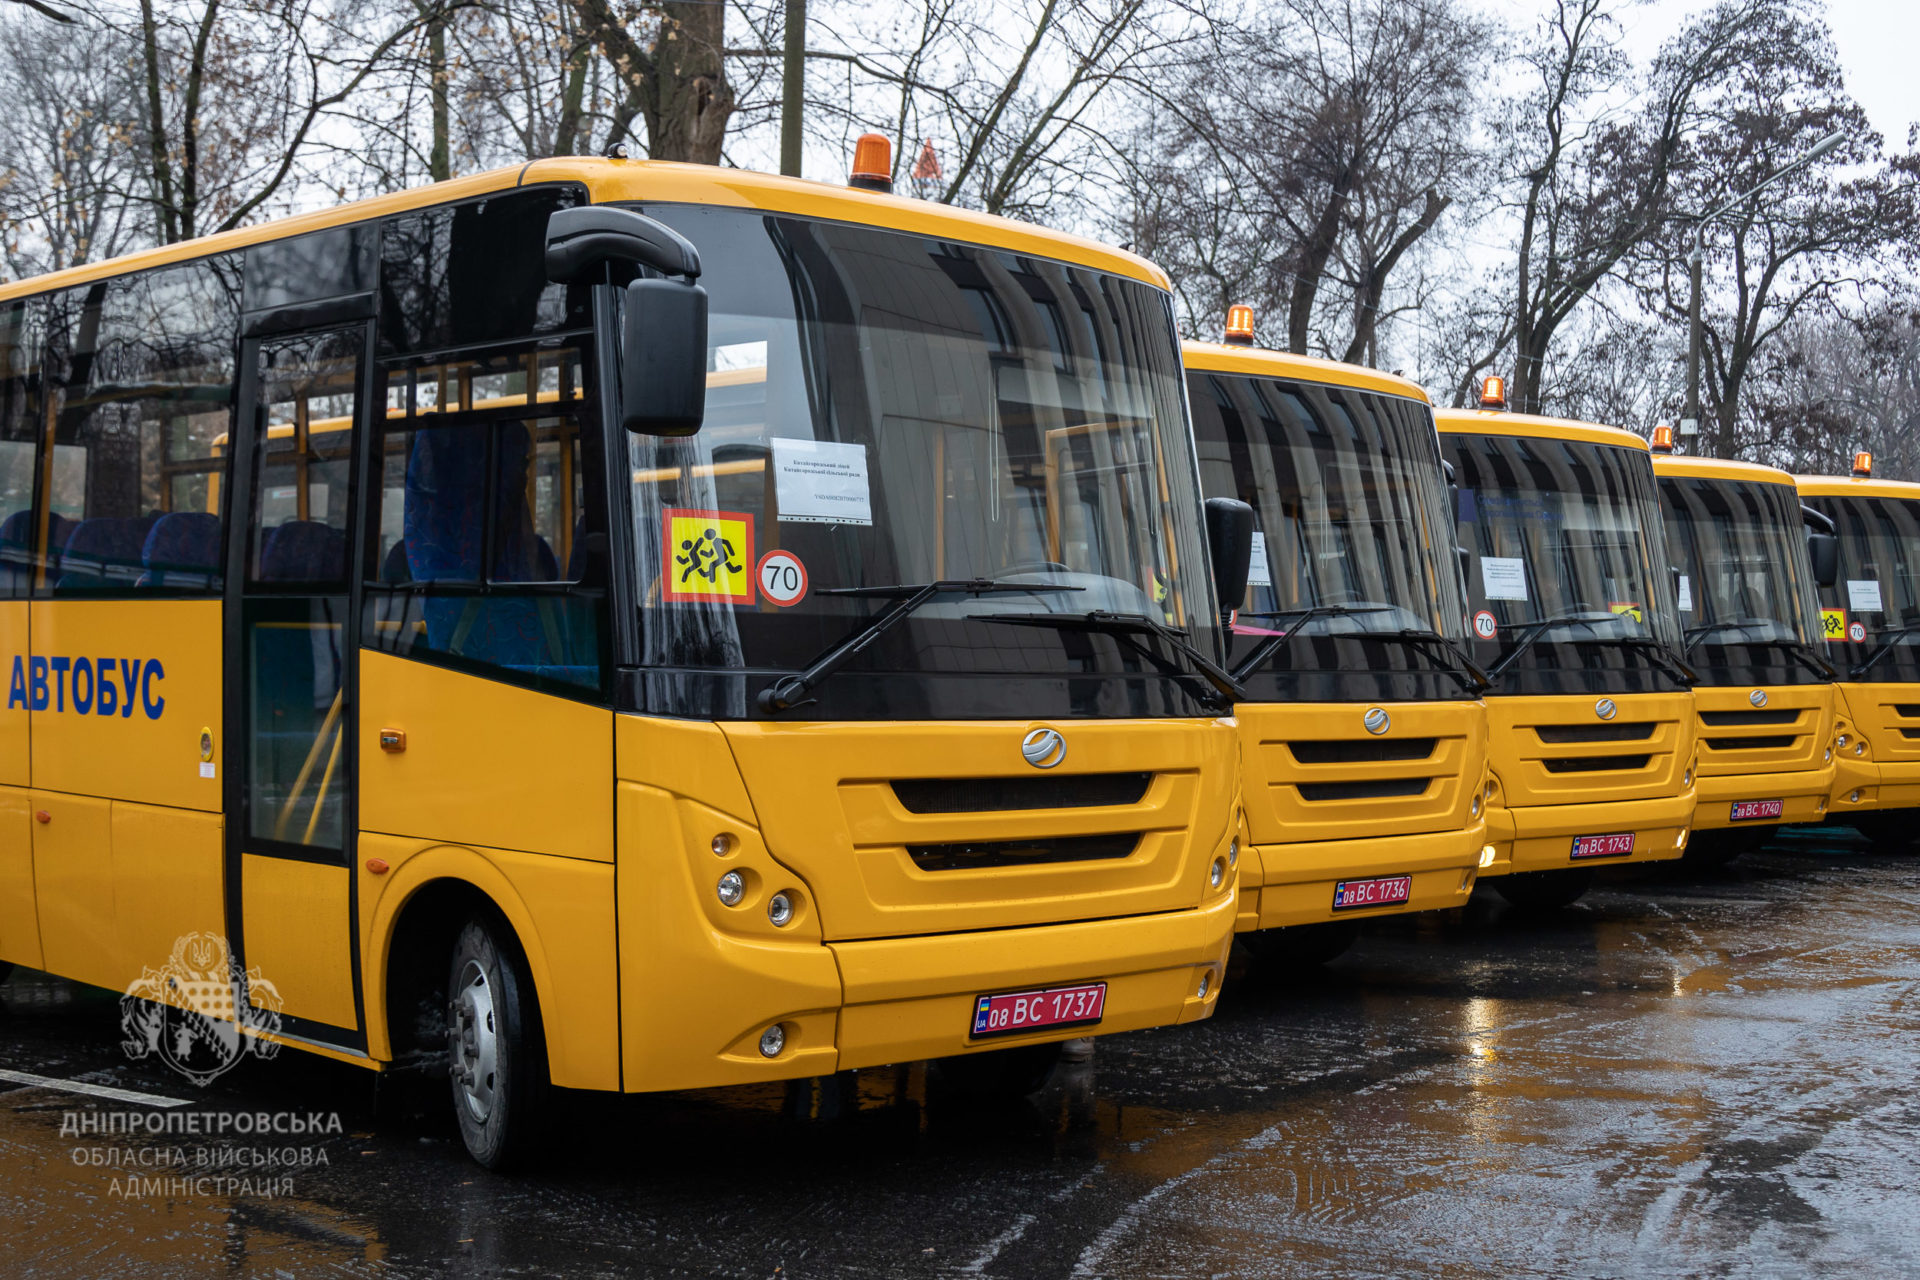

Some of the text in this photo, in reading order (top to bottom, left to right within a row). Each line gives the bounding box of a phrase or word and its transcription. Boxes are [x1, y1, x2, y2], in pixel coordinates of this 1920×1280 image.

[766, 565, 798, 591] 70
[1478, 618, 1493, 631] 70
[1851, 627, 1863, 637] 70
[8, 655, 165, 720] АВТОБУС
[1761, 803, 1779, 815] 1740
[1579, 837, 1630, 854] 08 BC 1743
[1343, 891, 1355, 904] 08
[1357, 884, 1375, 902] BC
[1380, 880, 1406, 900] 1736
[989, 1008, 1009, 1028] 08
[1012, 996, 1044, 1025] BC
[1052, 990, 1099, 1019] 1737
